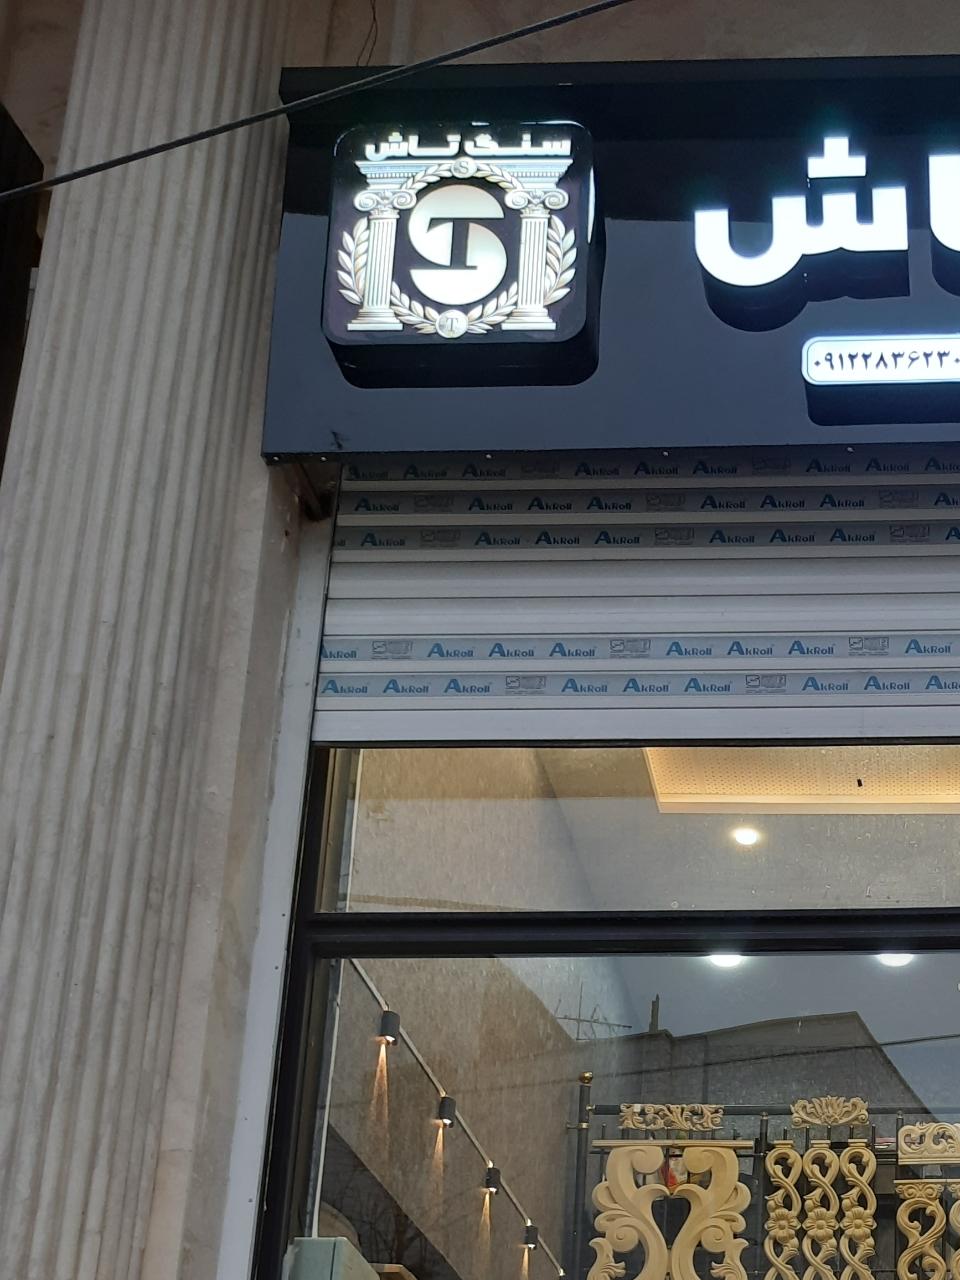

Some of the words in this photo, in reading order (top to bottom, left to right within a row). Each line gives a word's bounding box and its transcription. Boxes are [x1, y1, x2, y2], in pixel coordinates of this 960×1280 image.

[365, 132, 461, 161] تاش
[464, 133, 571, 157] سنگ
[814, 350, 960, 371] ۰۹۱۲۲۸۳۶۲۳۰
[427, 643, 473, 657] AkRoll
[488, 643, 534, 657] AkRoll
[550, 643, 595, 657] AkRoll
[666, 642, 712, 656] AkRoll
[727, 641, 772, 655] AkRoll
[788, 640, 834, 655] AkRoll
[905, 639, 950, 653] AkRoll
[322, 679, 367, 694] AkRoll
[383, 679, 429, 693] AkRoll
[444, 679, 490, 693] AkRoll
[561, 679, 607, 692] AkRoll
[623, 678, 669, 692] AkRoll
[684, 678, 730, 692] AkRoll
[802, 676, 848, 691] AkRoll
[864, 676, 910, 690] AkRoll
